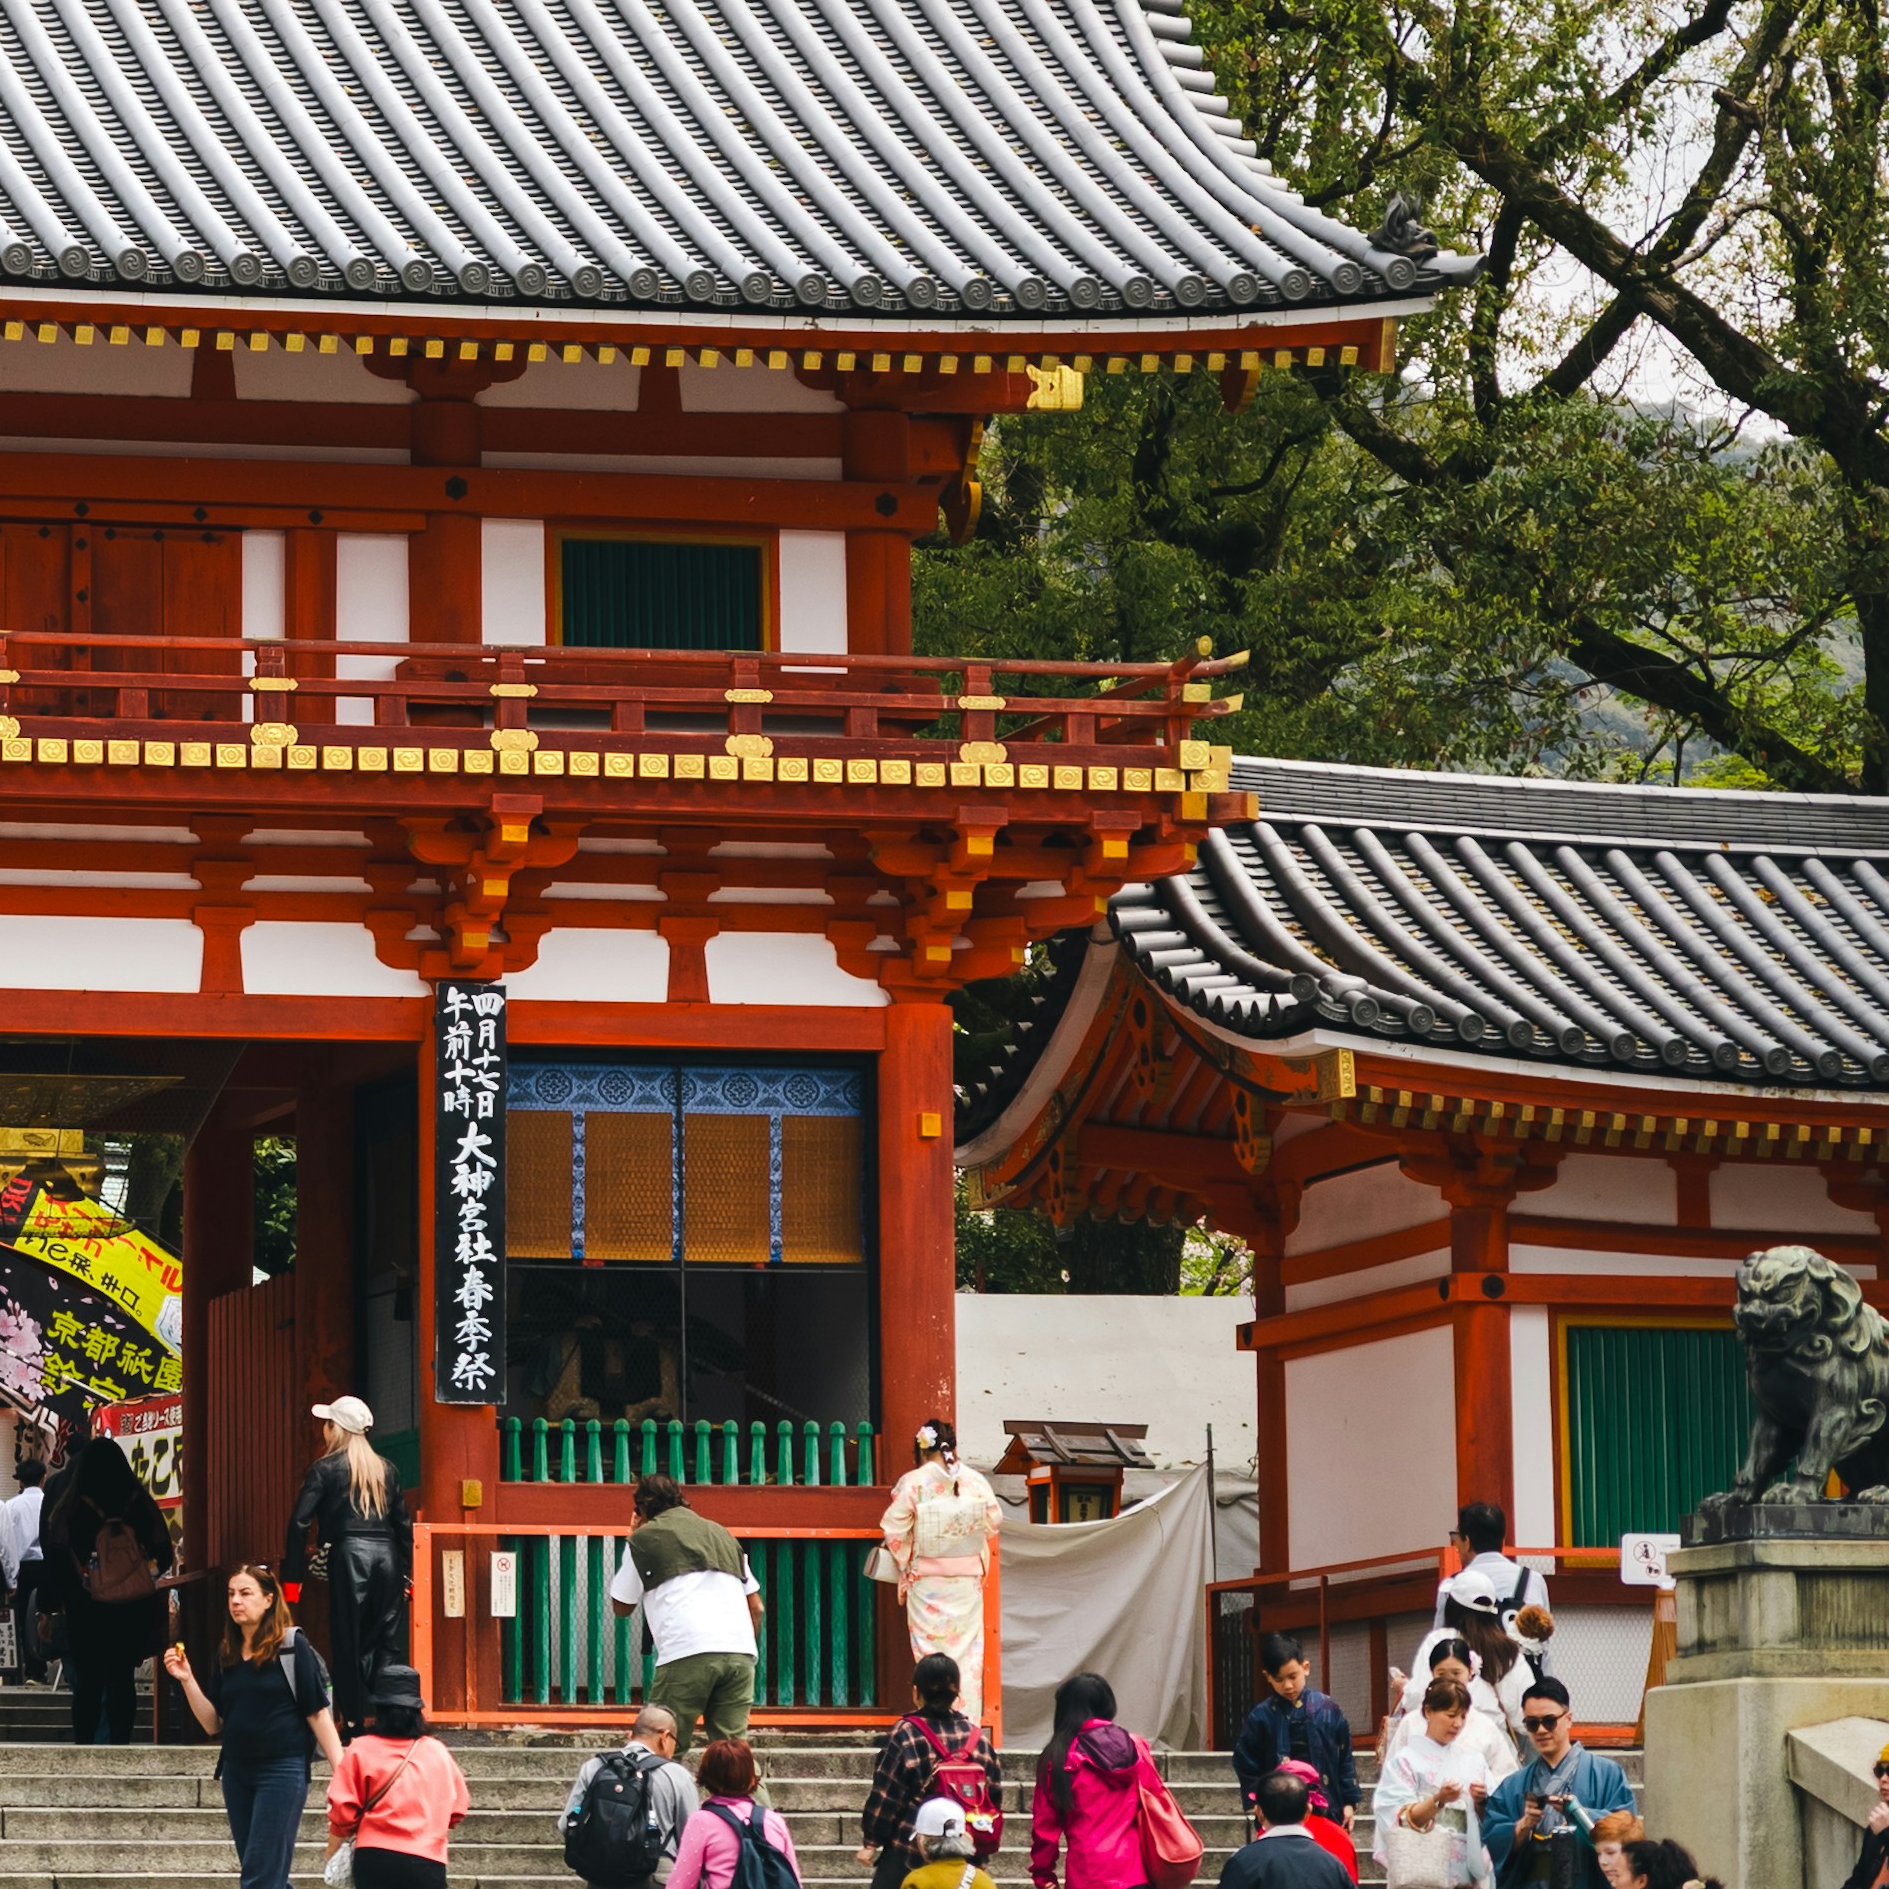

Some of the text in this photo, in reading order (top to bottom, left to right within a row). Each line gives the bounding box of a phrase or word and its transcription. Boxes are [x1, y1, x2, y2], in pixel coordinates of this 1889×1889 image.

[443, 986, 476, 1119] 午前十時
[471, 993, 505, 1119] 四月十七日
[450, 1121, 497, 1390] 大神宮社春季祭
